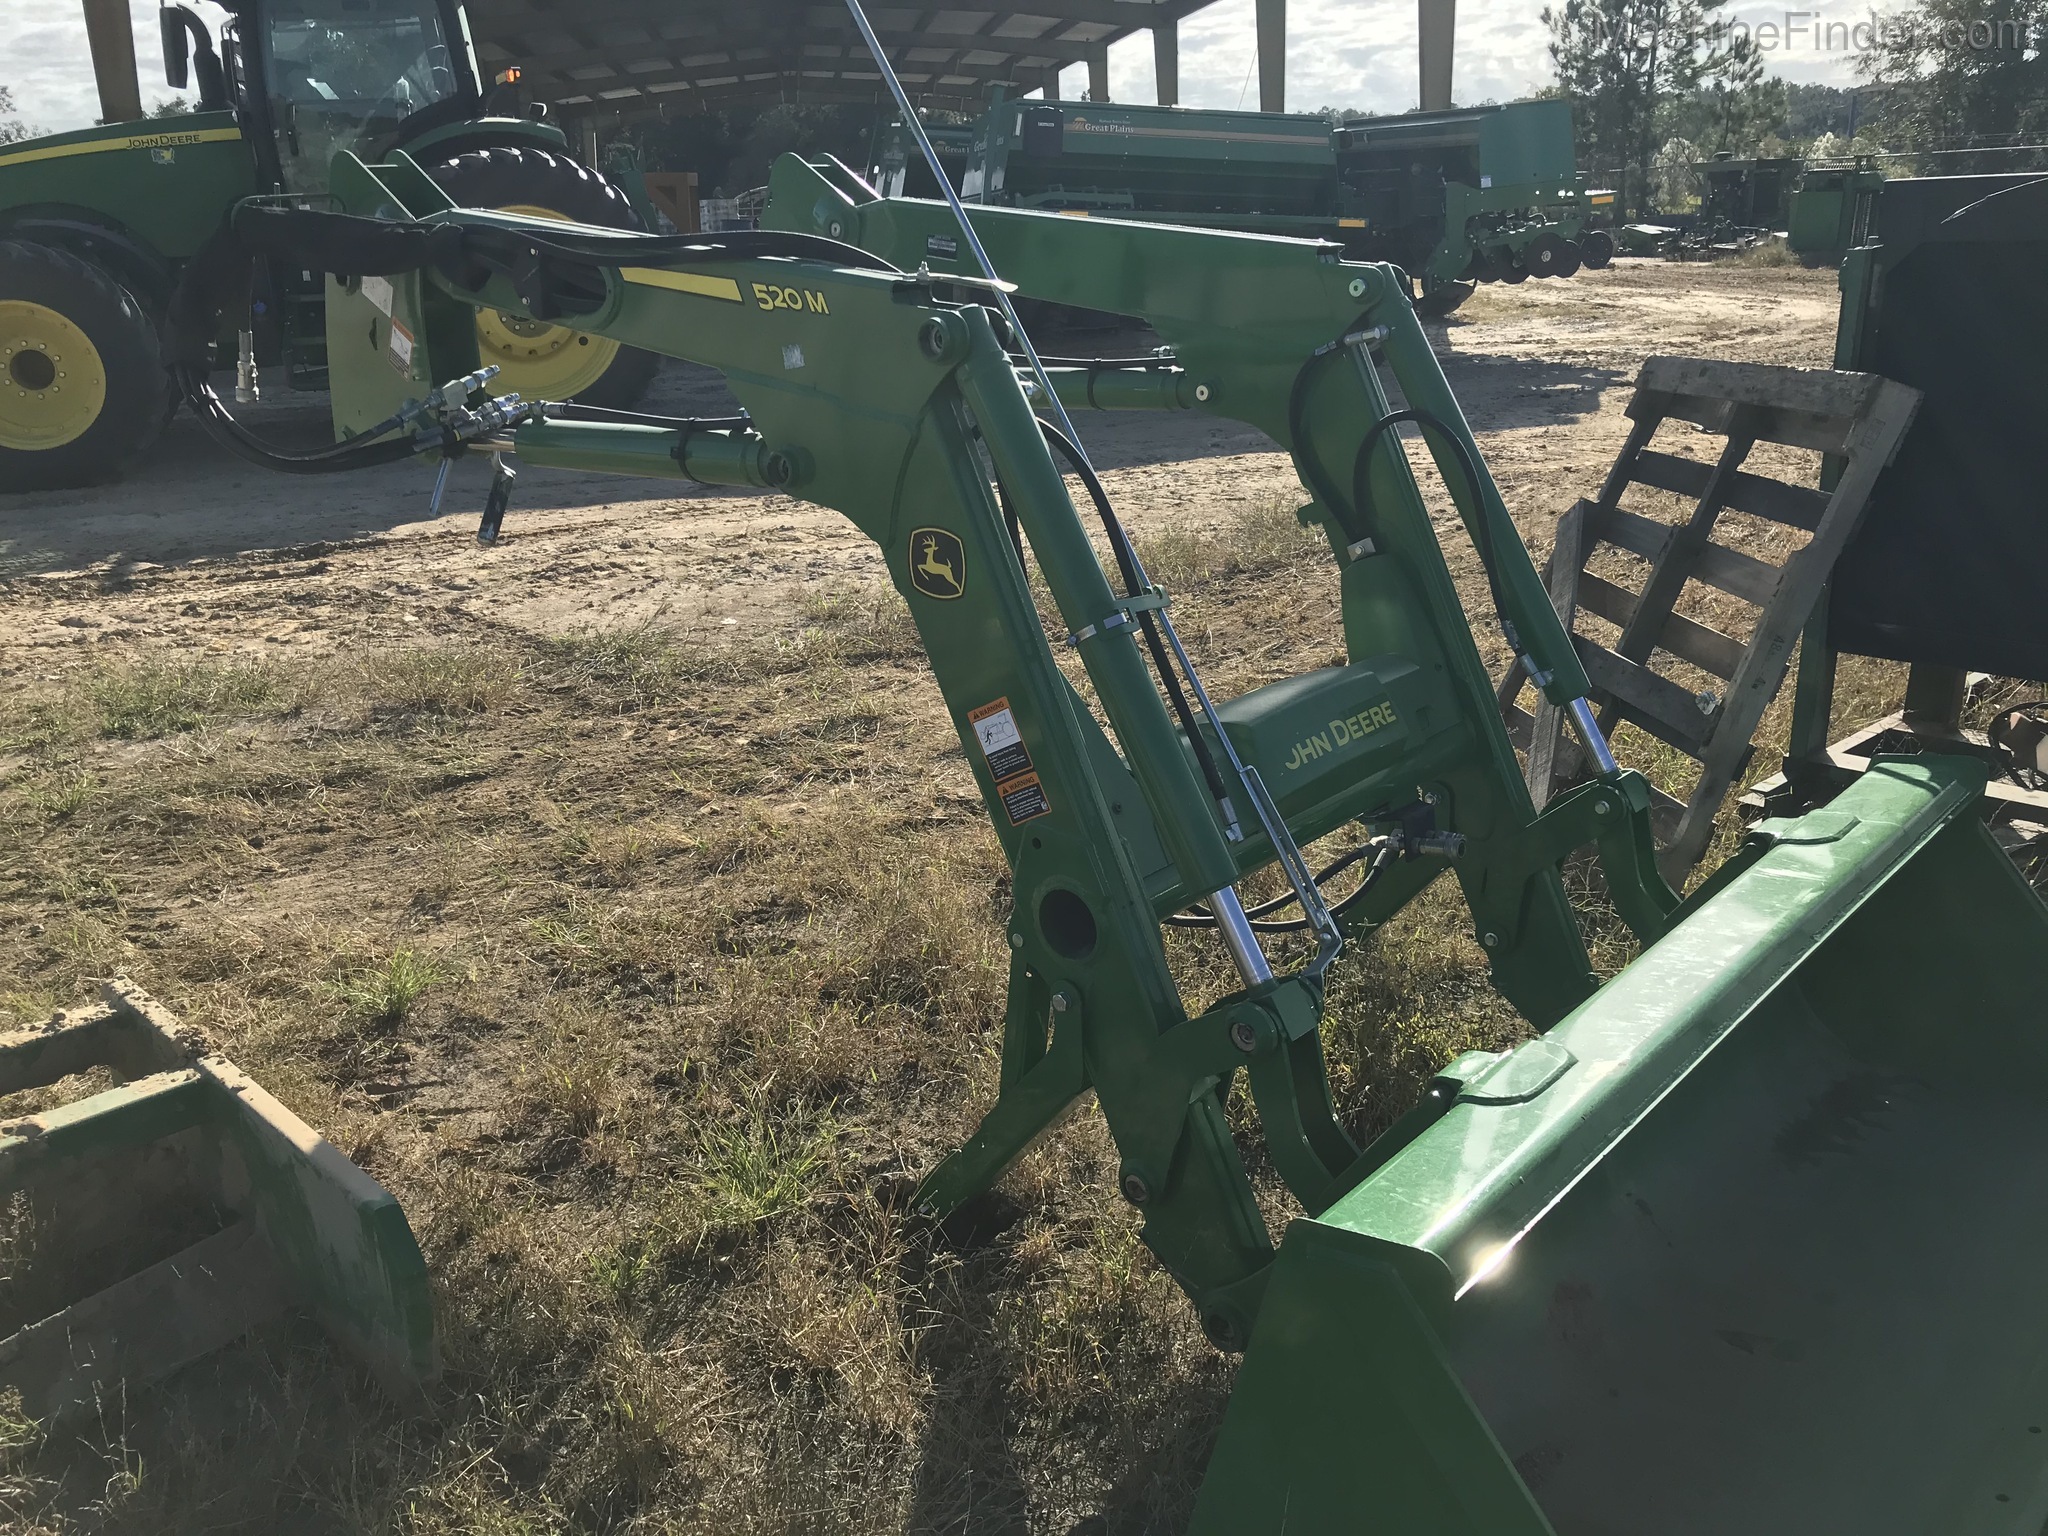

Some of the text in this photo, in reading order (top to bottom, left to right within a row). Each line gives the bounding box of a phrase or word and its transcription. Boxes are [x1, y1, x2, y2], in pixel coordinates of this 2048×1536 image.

[1084, 123, 1134, 133] Great Plains
[126, 134, 201, 149] JOHN DEERE
[751, 282, 830, 315] 520 M
[979, 700, 1005, 718] WARNING
[1328, 700, 1397, 747] DEERE
[1008, 776, 1035, 791] WARNING
